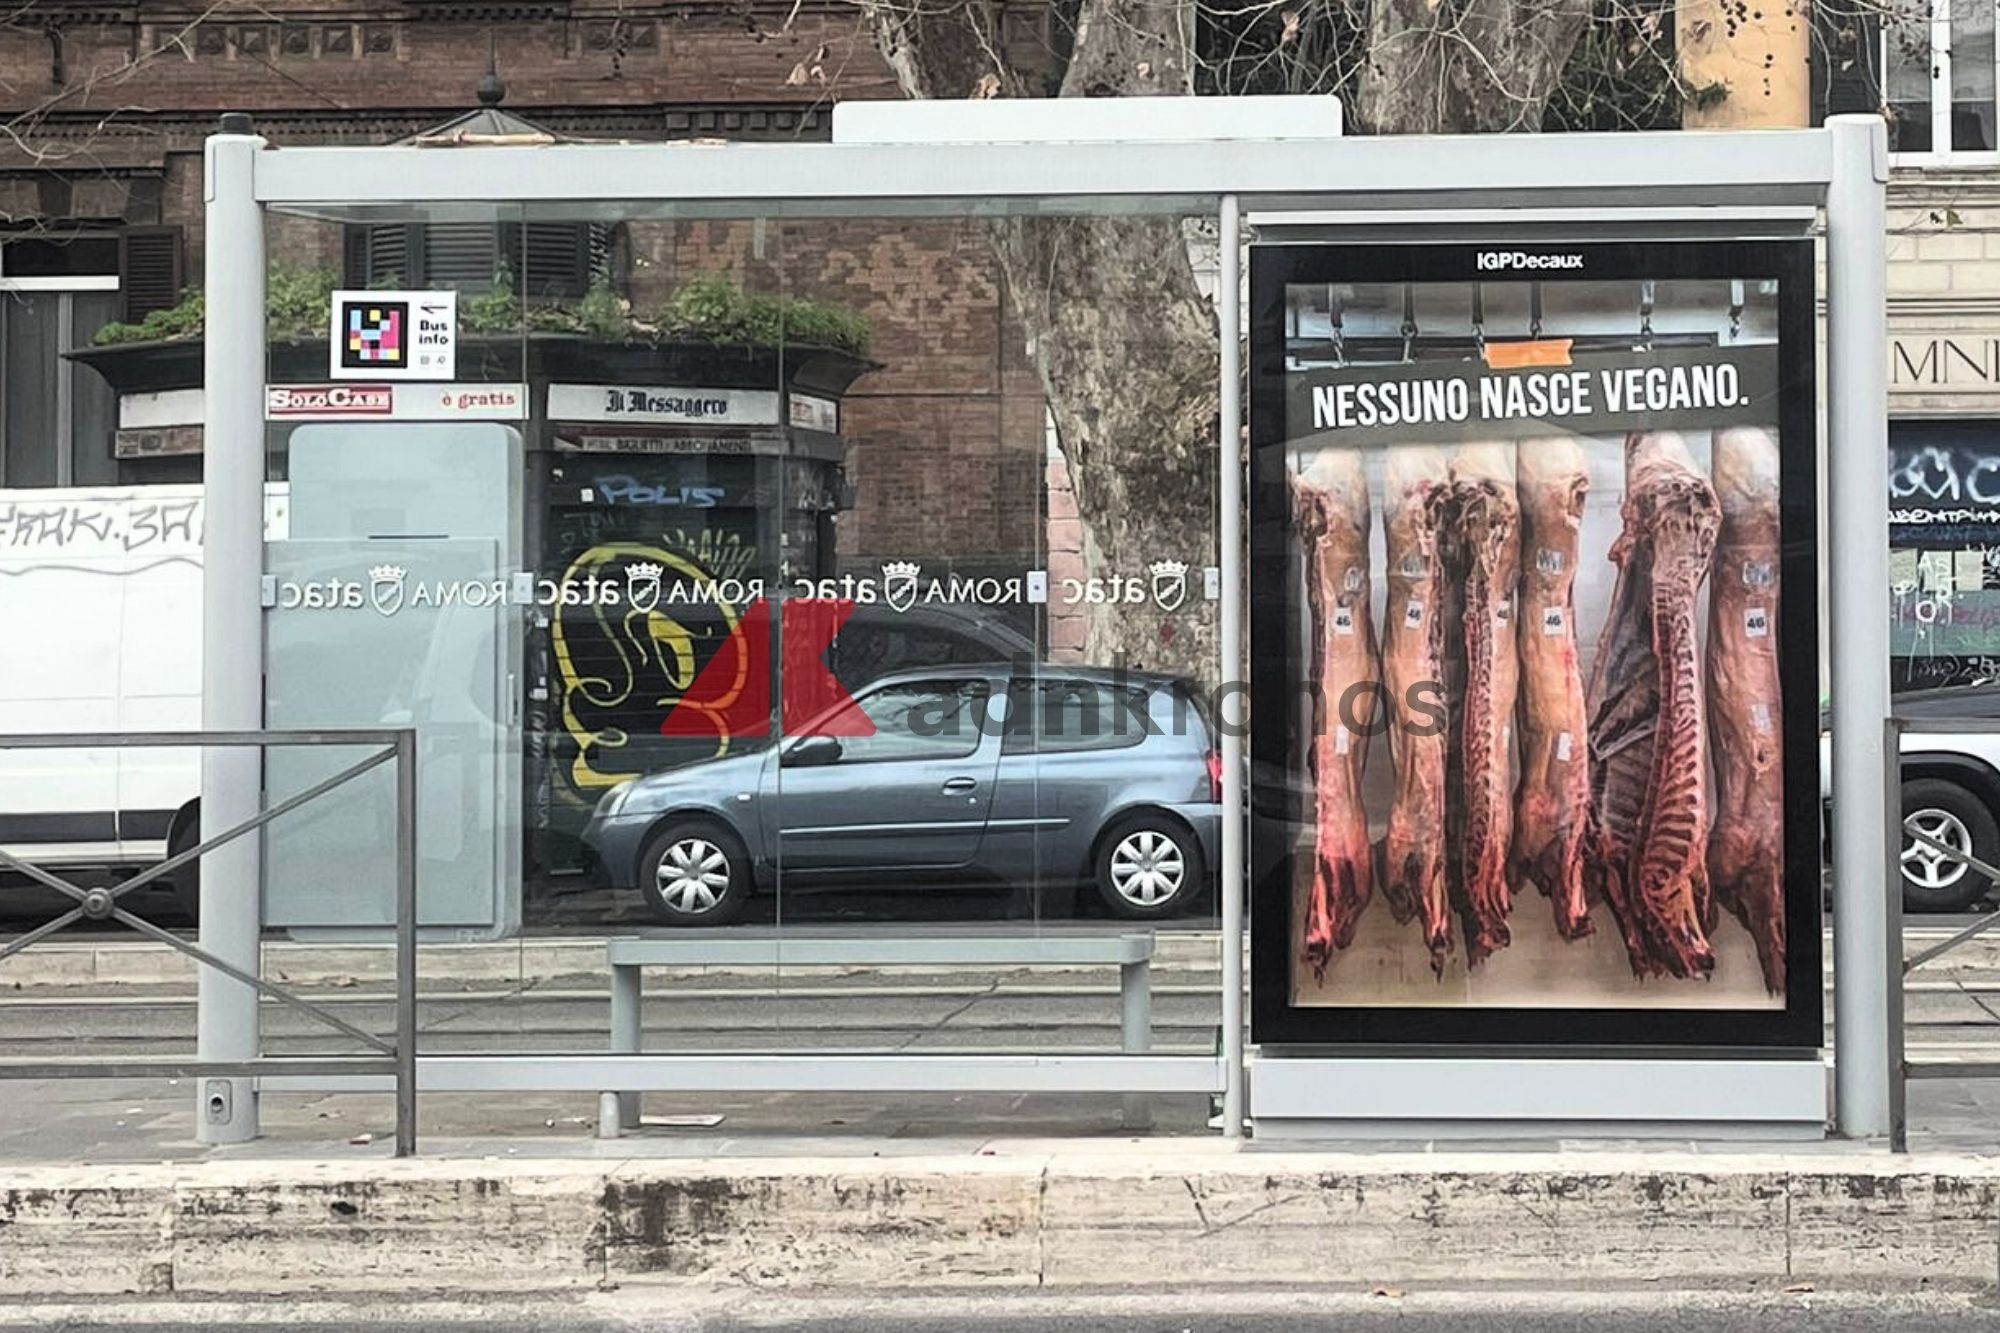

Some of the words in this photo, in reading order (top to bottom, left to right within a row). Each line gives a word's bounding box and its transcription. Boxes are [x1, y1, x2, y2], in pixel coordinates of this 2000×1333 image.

[1477, 252, 1583, 270] IGPDecaux
[420, 320, 448, 331] Bus
[419, 334, 448, 345] info
[458, 393, 515, 409] gratis
[1312, 378, 1469, 428] NESSUNO
[1481, 372, 1592, 418] NASCE
[1602, 364, 1749, 412] VEGANO.
